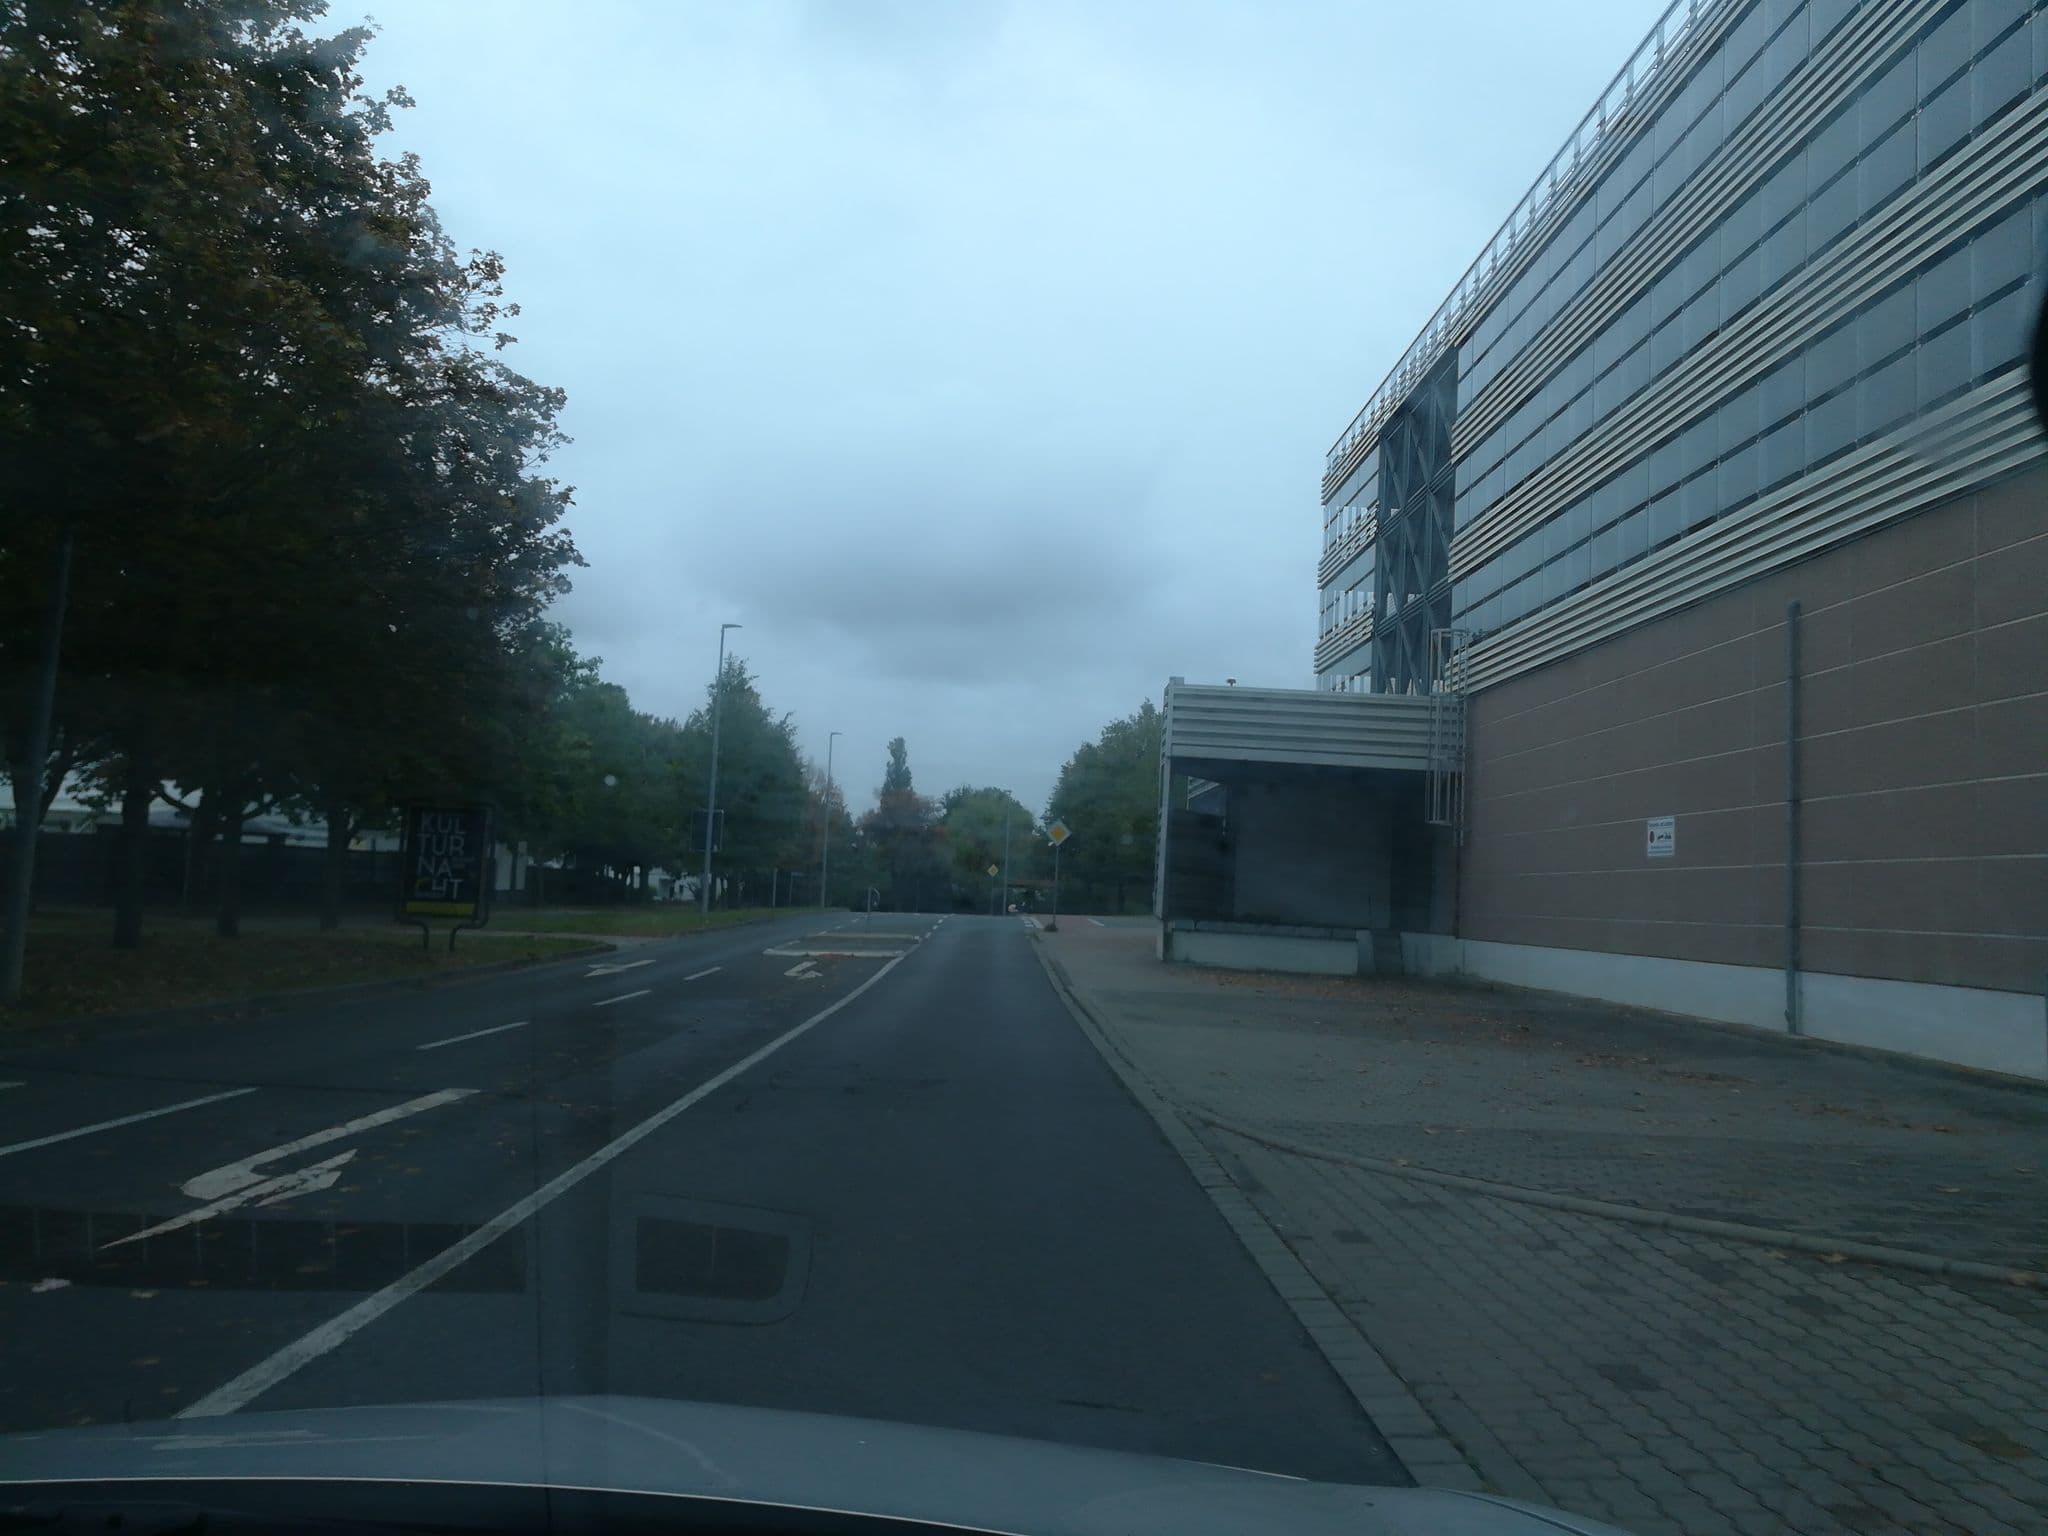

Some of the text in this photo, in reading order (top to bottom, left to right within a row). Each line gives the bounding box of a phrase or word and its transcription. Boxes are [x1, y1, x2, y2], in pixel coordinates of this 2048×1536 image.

[421, 812, 466, 835] KUL
[415, 833, 465, 856] TUR
[416, 855, 453, 878] NA
